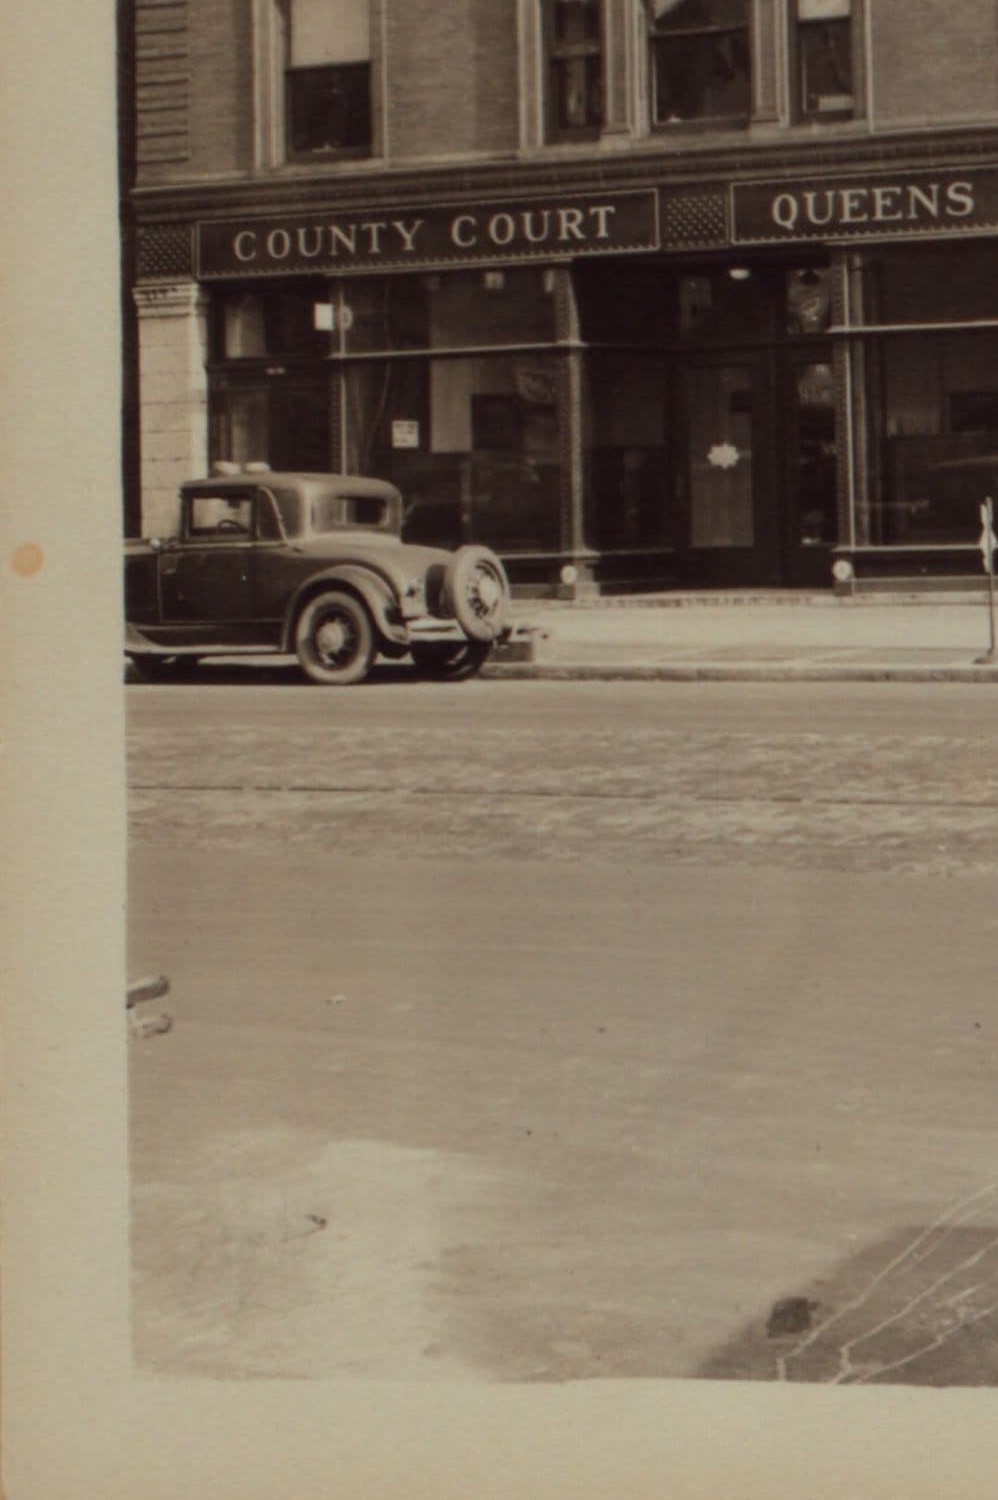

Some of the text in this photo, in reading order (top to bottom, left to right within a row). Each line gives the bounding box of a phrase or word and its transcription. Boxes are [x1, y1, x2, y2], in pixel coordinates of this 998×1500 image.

[771, 181, 975, 230] QUEENS
[233, 205, 616, 261] COUNTY COURT
